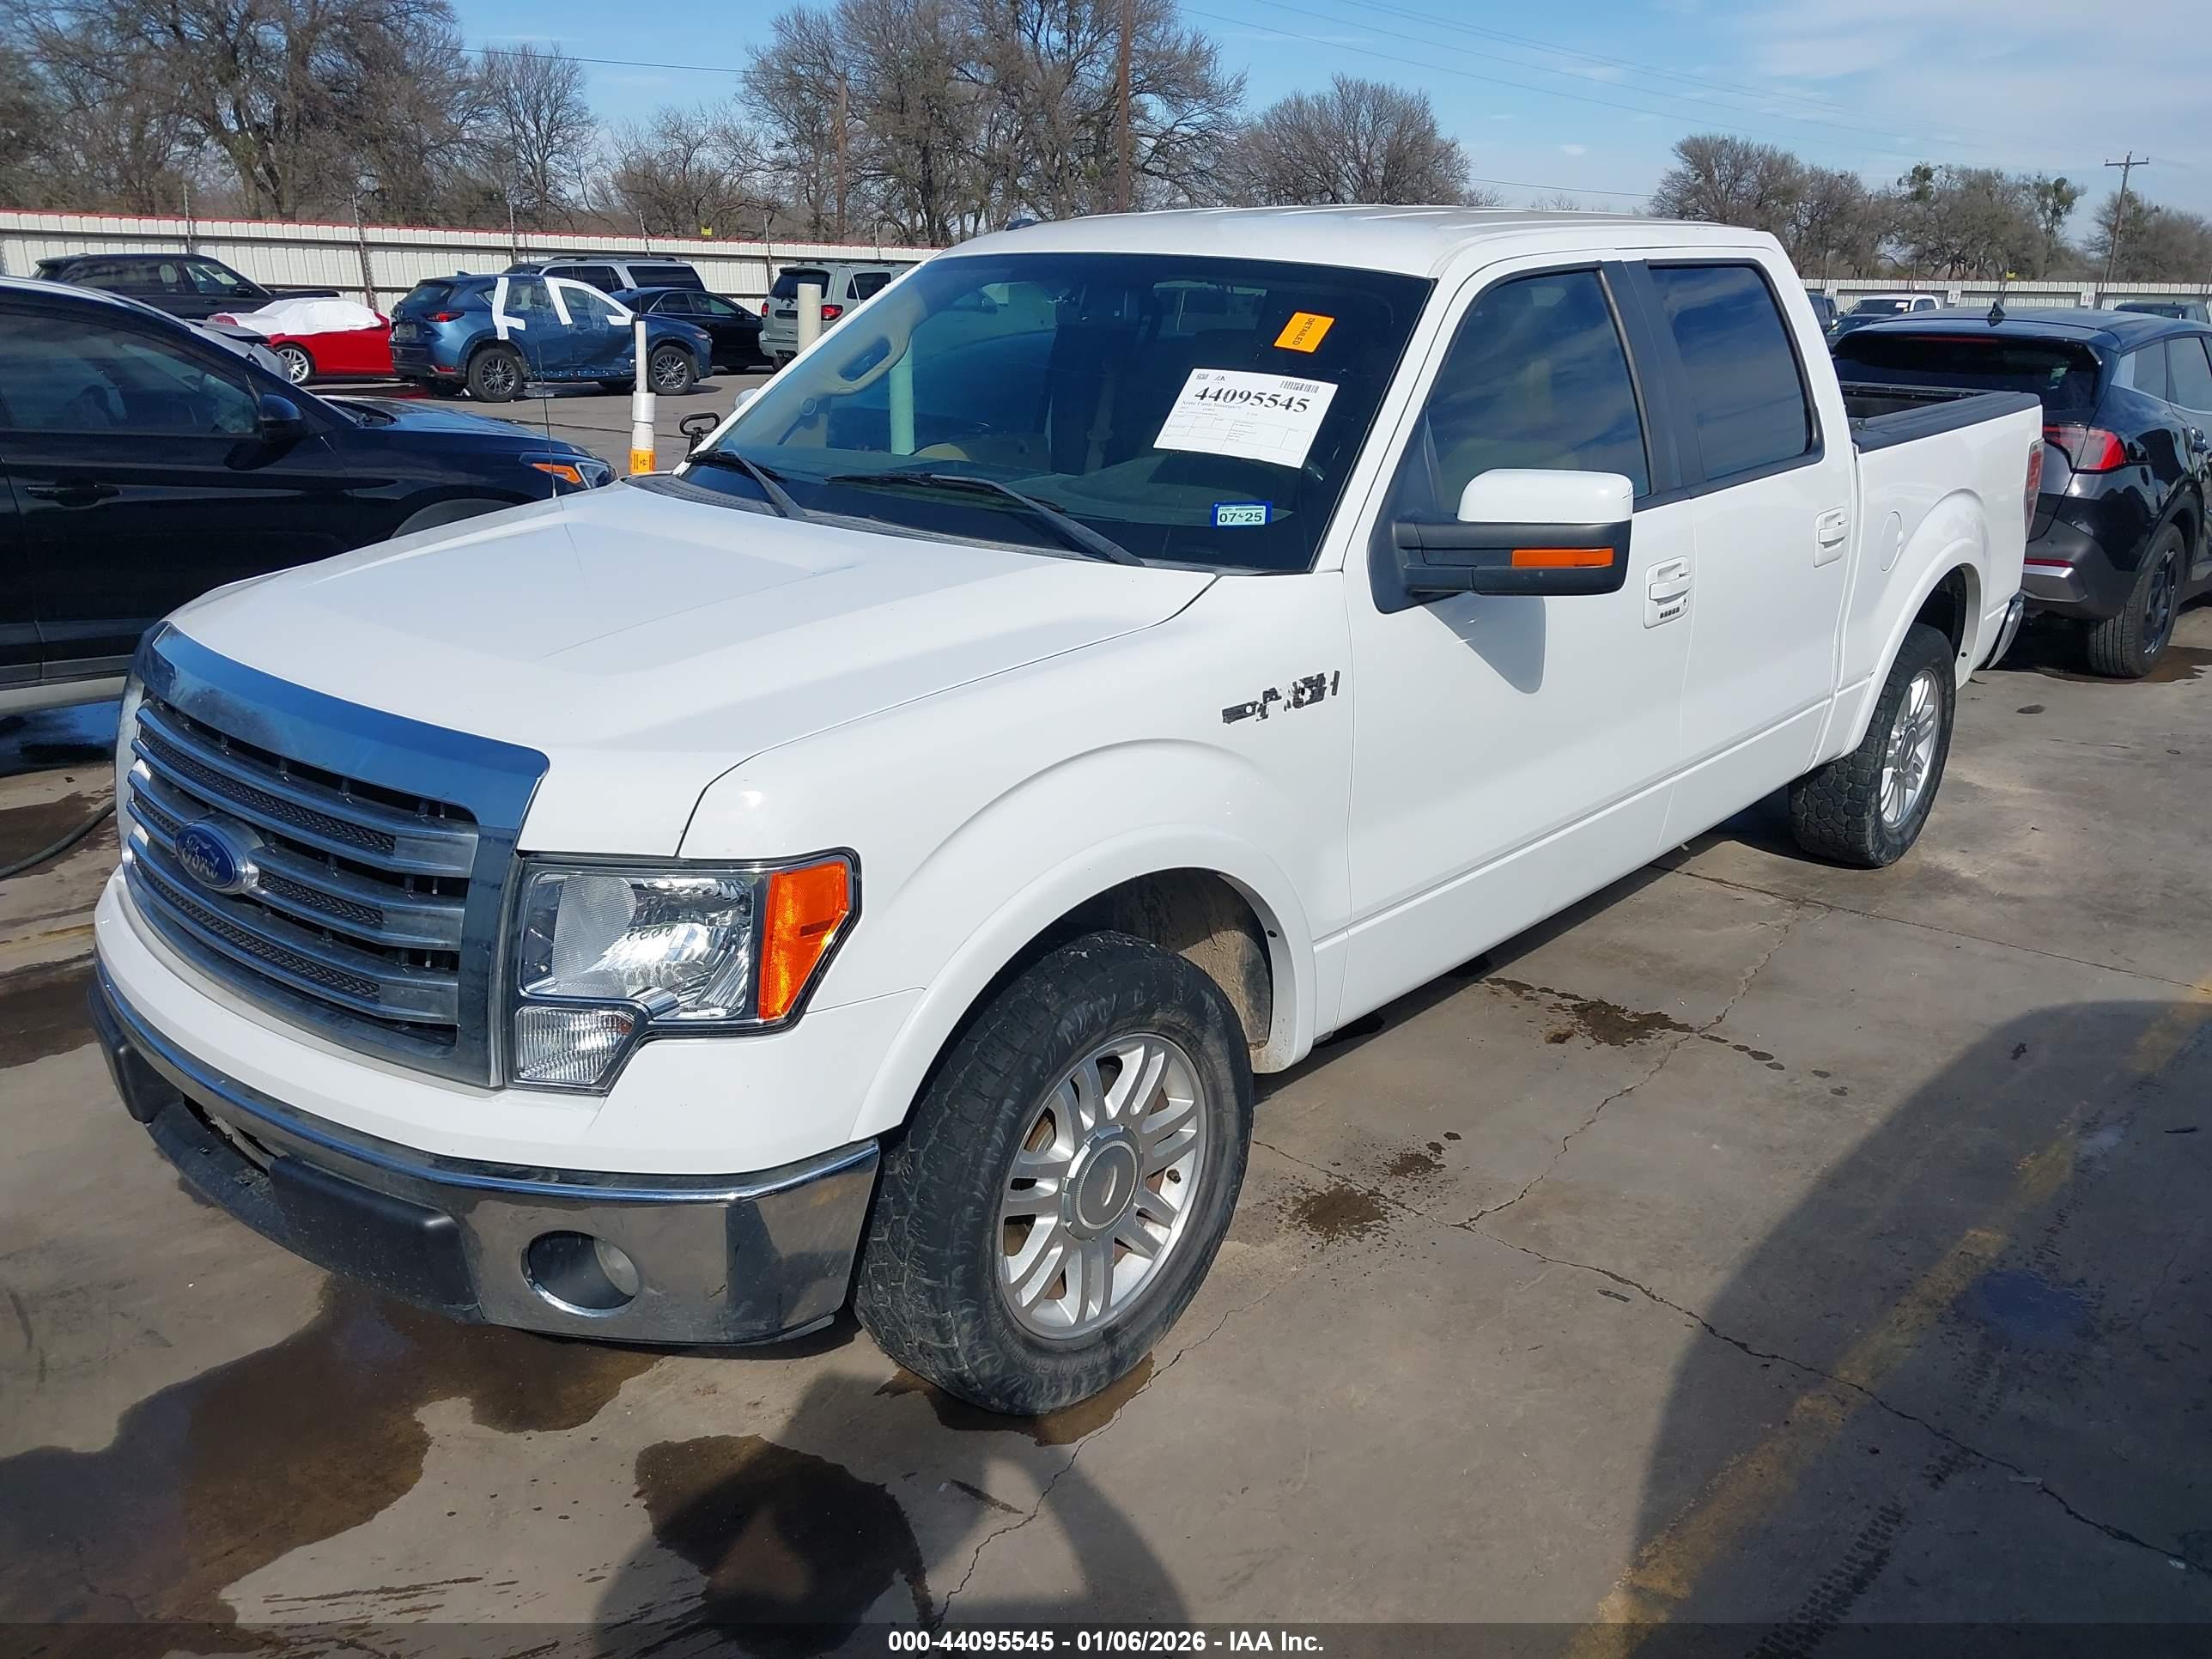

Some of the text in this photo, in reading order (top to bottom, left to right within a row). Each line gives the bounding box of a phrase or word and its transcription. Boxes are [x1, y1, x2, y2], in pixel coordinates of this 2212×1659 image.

[1292, 317, 1316, 345] DETAILED
[1194, 386, 1312, 414] 44095545
[1219, 512, 1262, 523] 07 25
[181, 834, 220, 880] Ford
